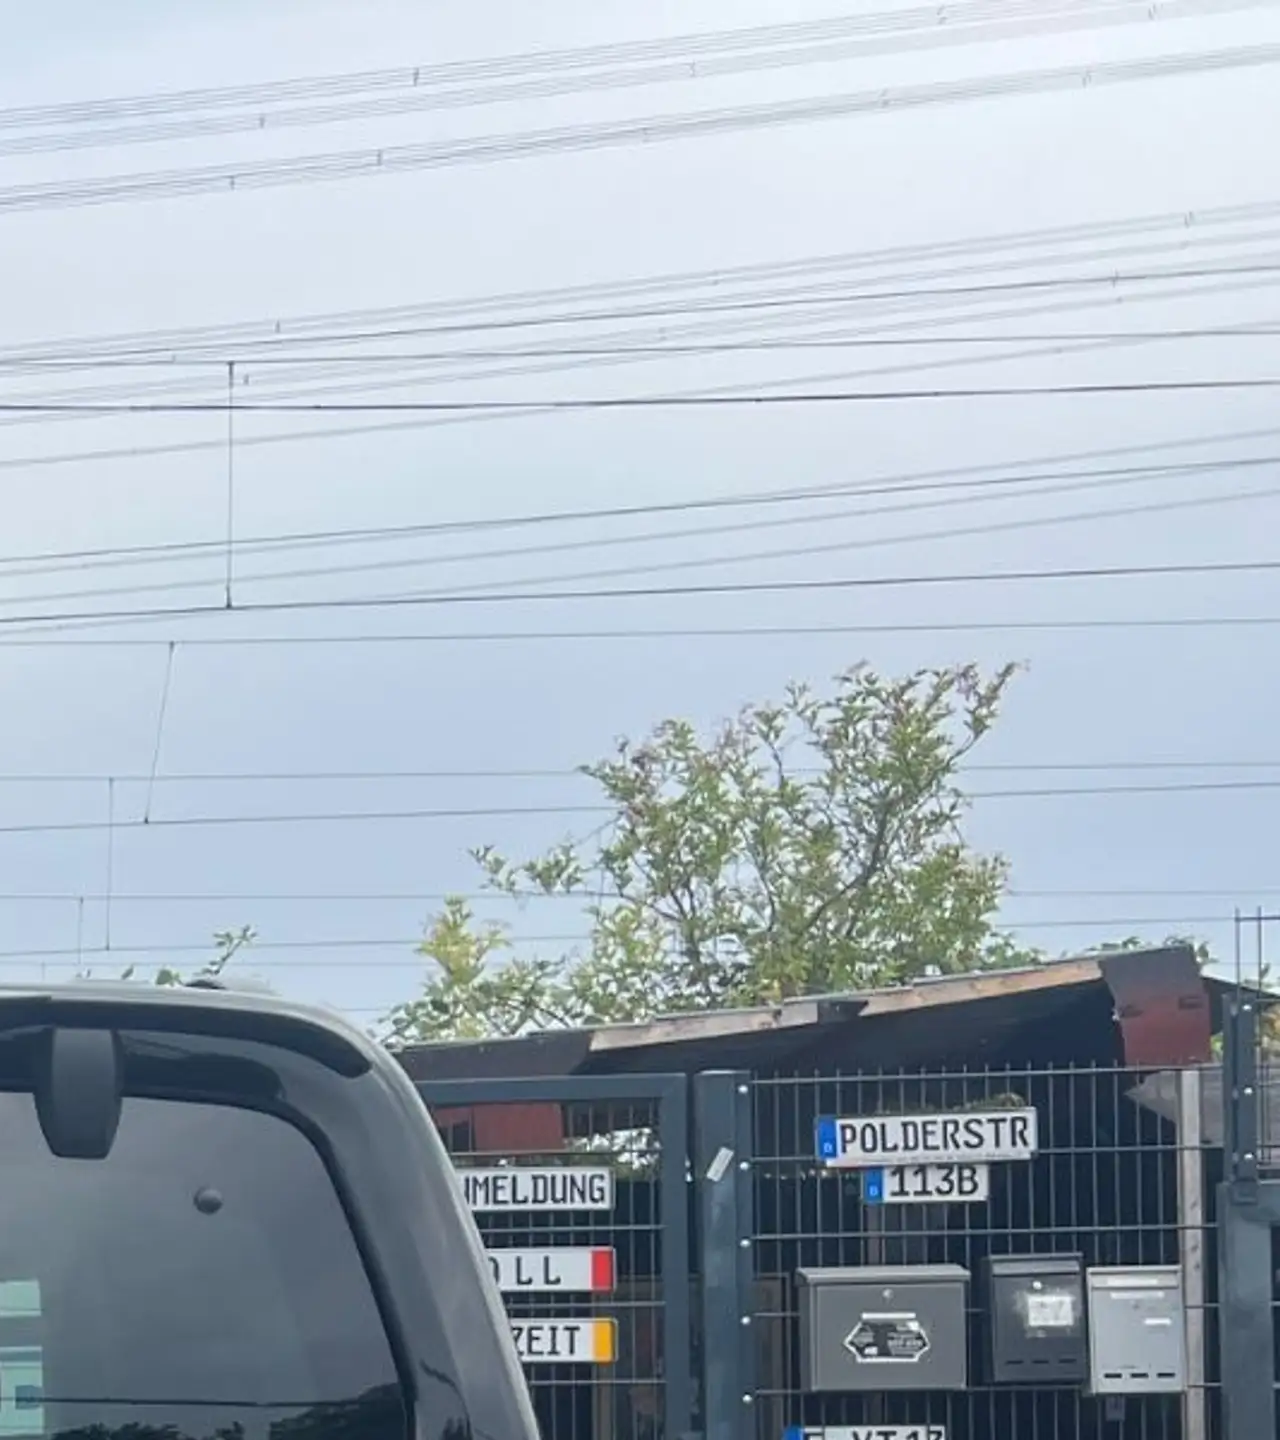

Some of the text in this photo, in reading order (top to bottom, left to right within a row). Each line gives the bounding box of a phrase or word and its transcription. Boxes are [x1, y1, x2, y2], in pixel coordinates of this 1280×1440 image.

[839, 1116, 1030, 1154] POLDERSTR
[890, 1165, 979, 1197] 113B
[511, 1325, 581, 1356] ZEIT
